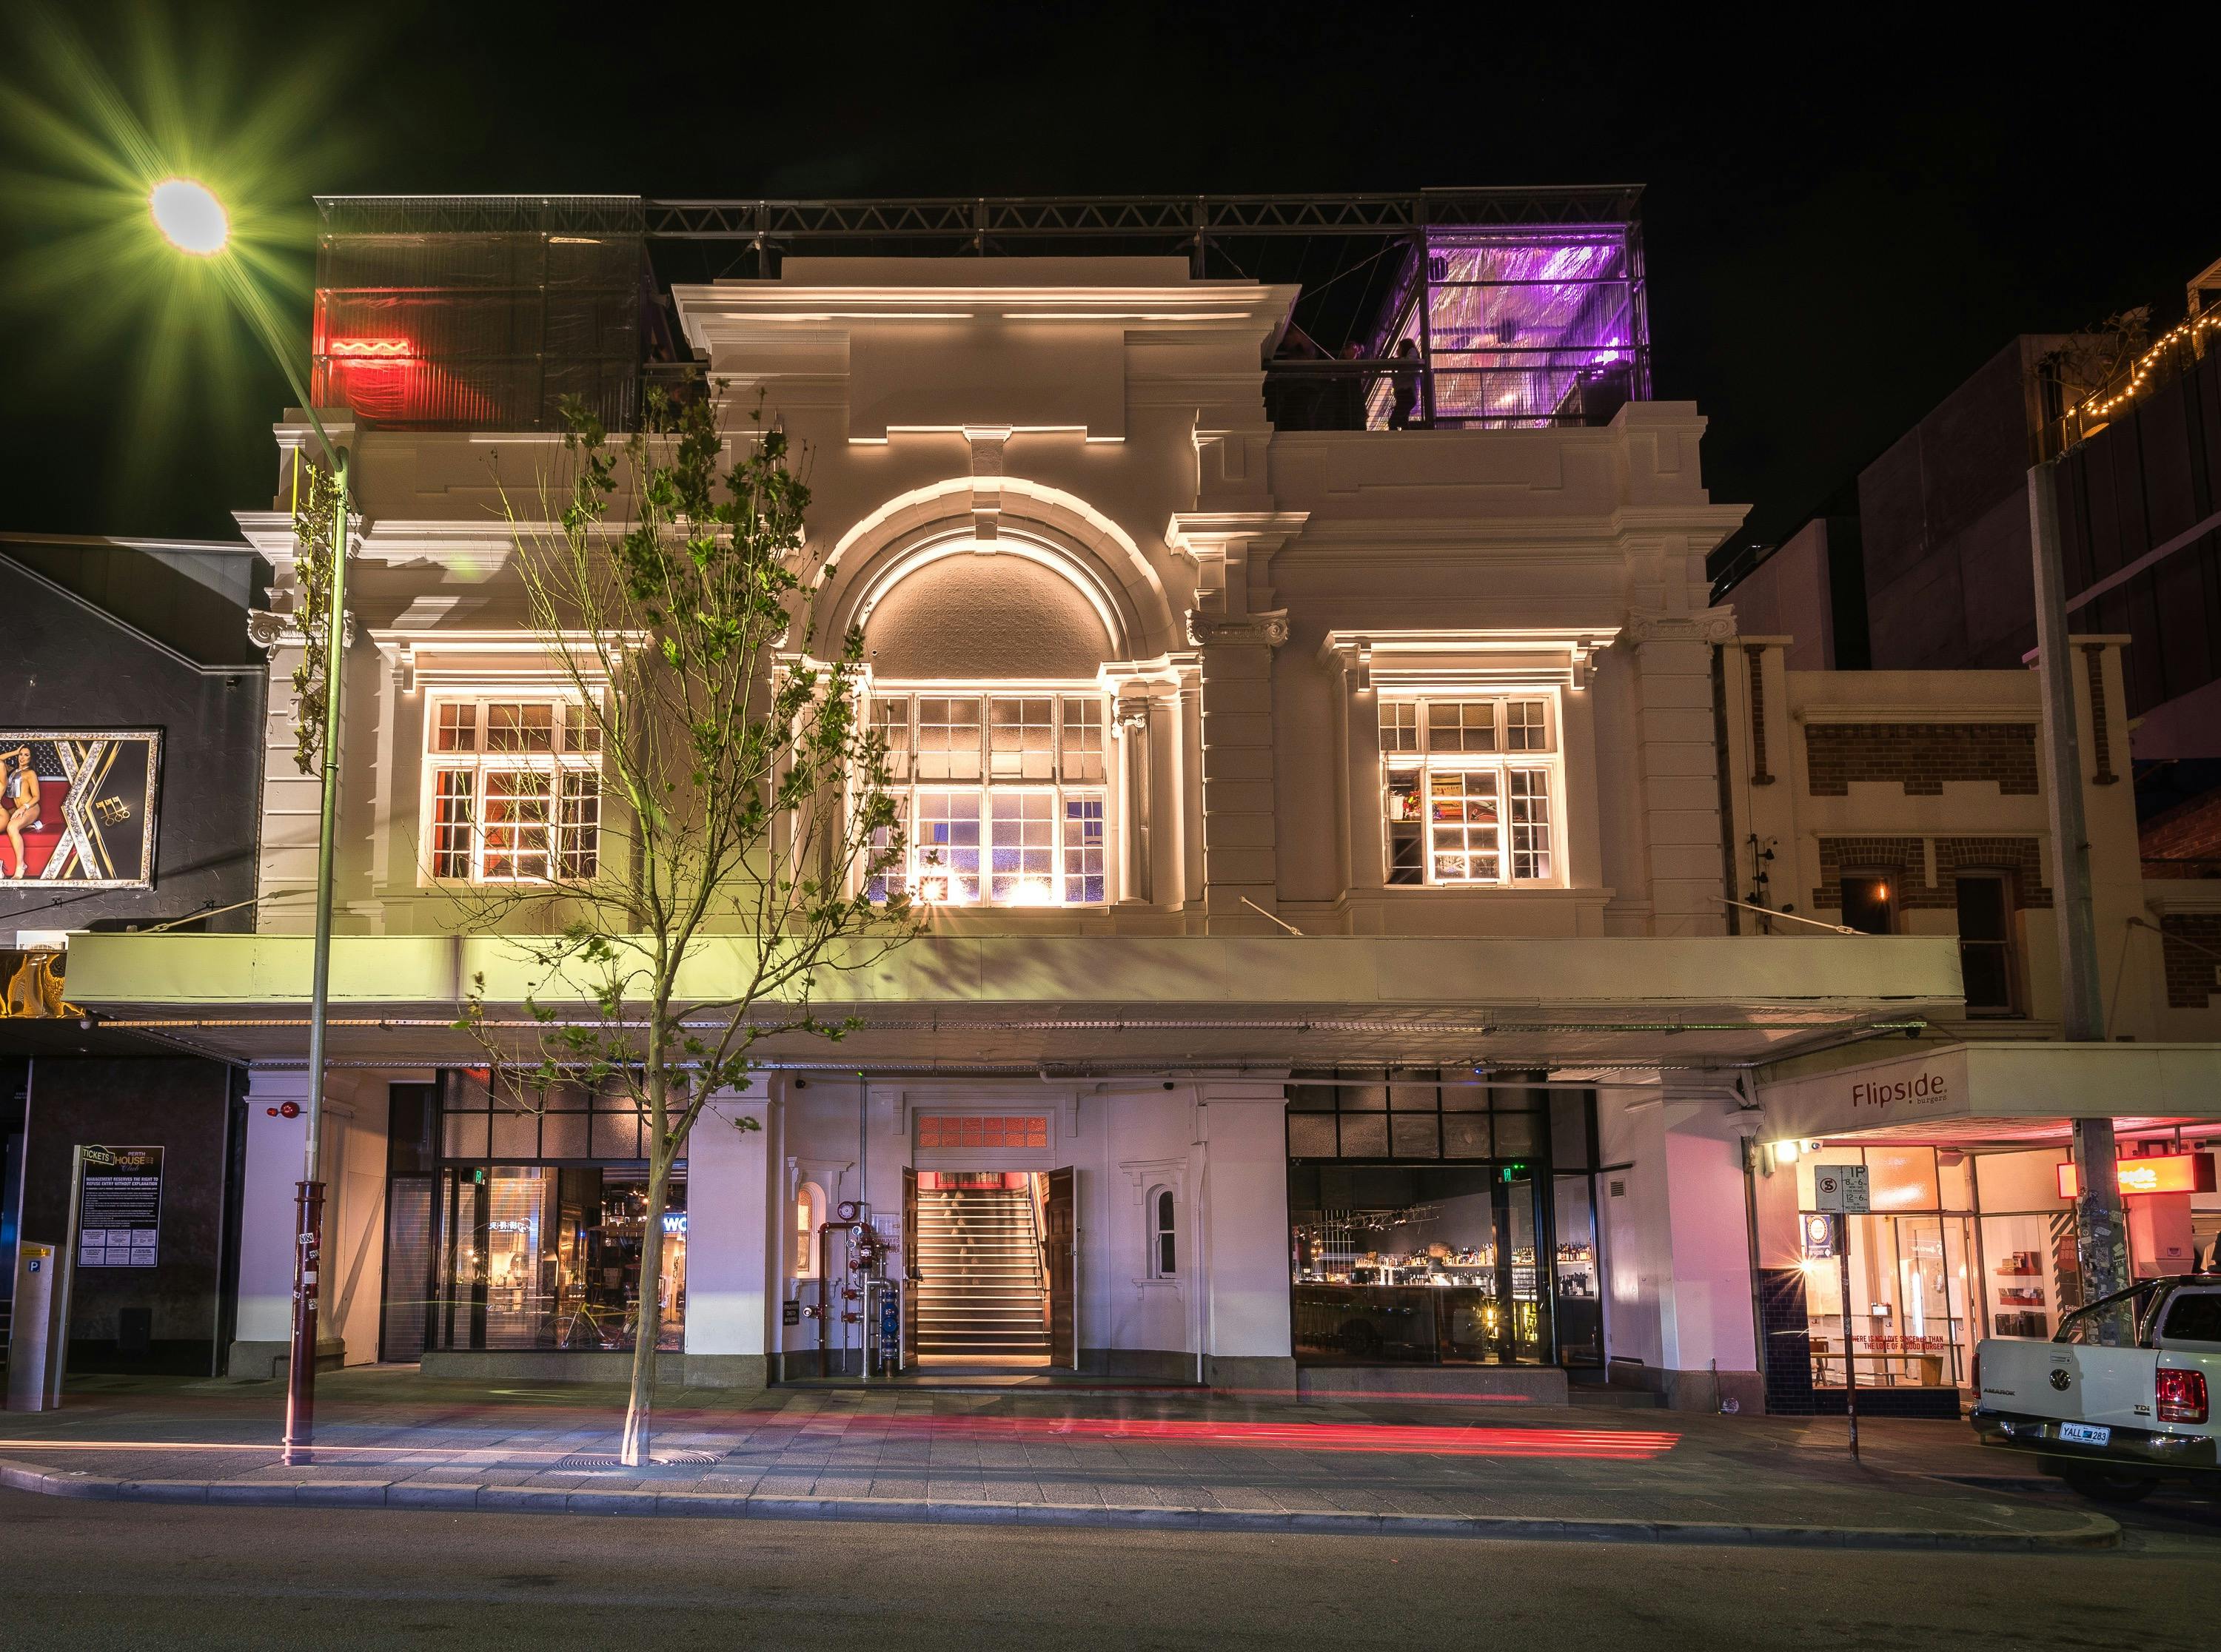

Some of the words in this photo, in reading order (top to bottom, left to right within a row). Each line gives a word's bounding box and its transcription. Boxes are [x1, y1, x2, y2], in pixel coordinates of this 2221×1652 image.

[1917, 1095, 1947, 1104] burgers
[83, 1149, 110, 1161] TICKETS
[114, 1156, 145, 1165] HOUSE
[1850, 1166, 1866, 1178] 1P
[1983, 1388, 2015, 1396] AMAROK
[2064, 1427, 2081, 1437] YALL
[2092, 1431, 2106, 1441] 283
